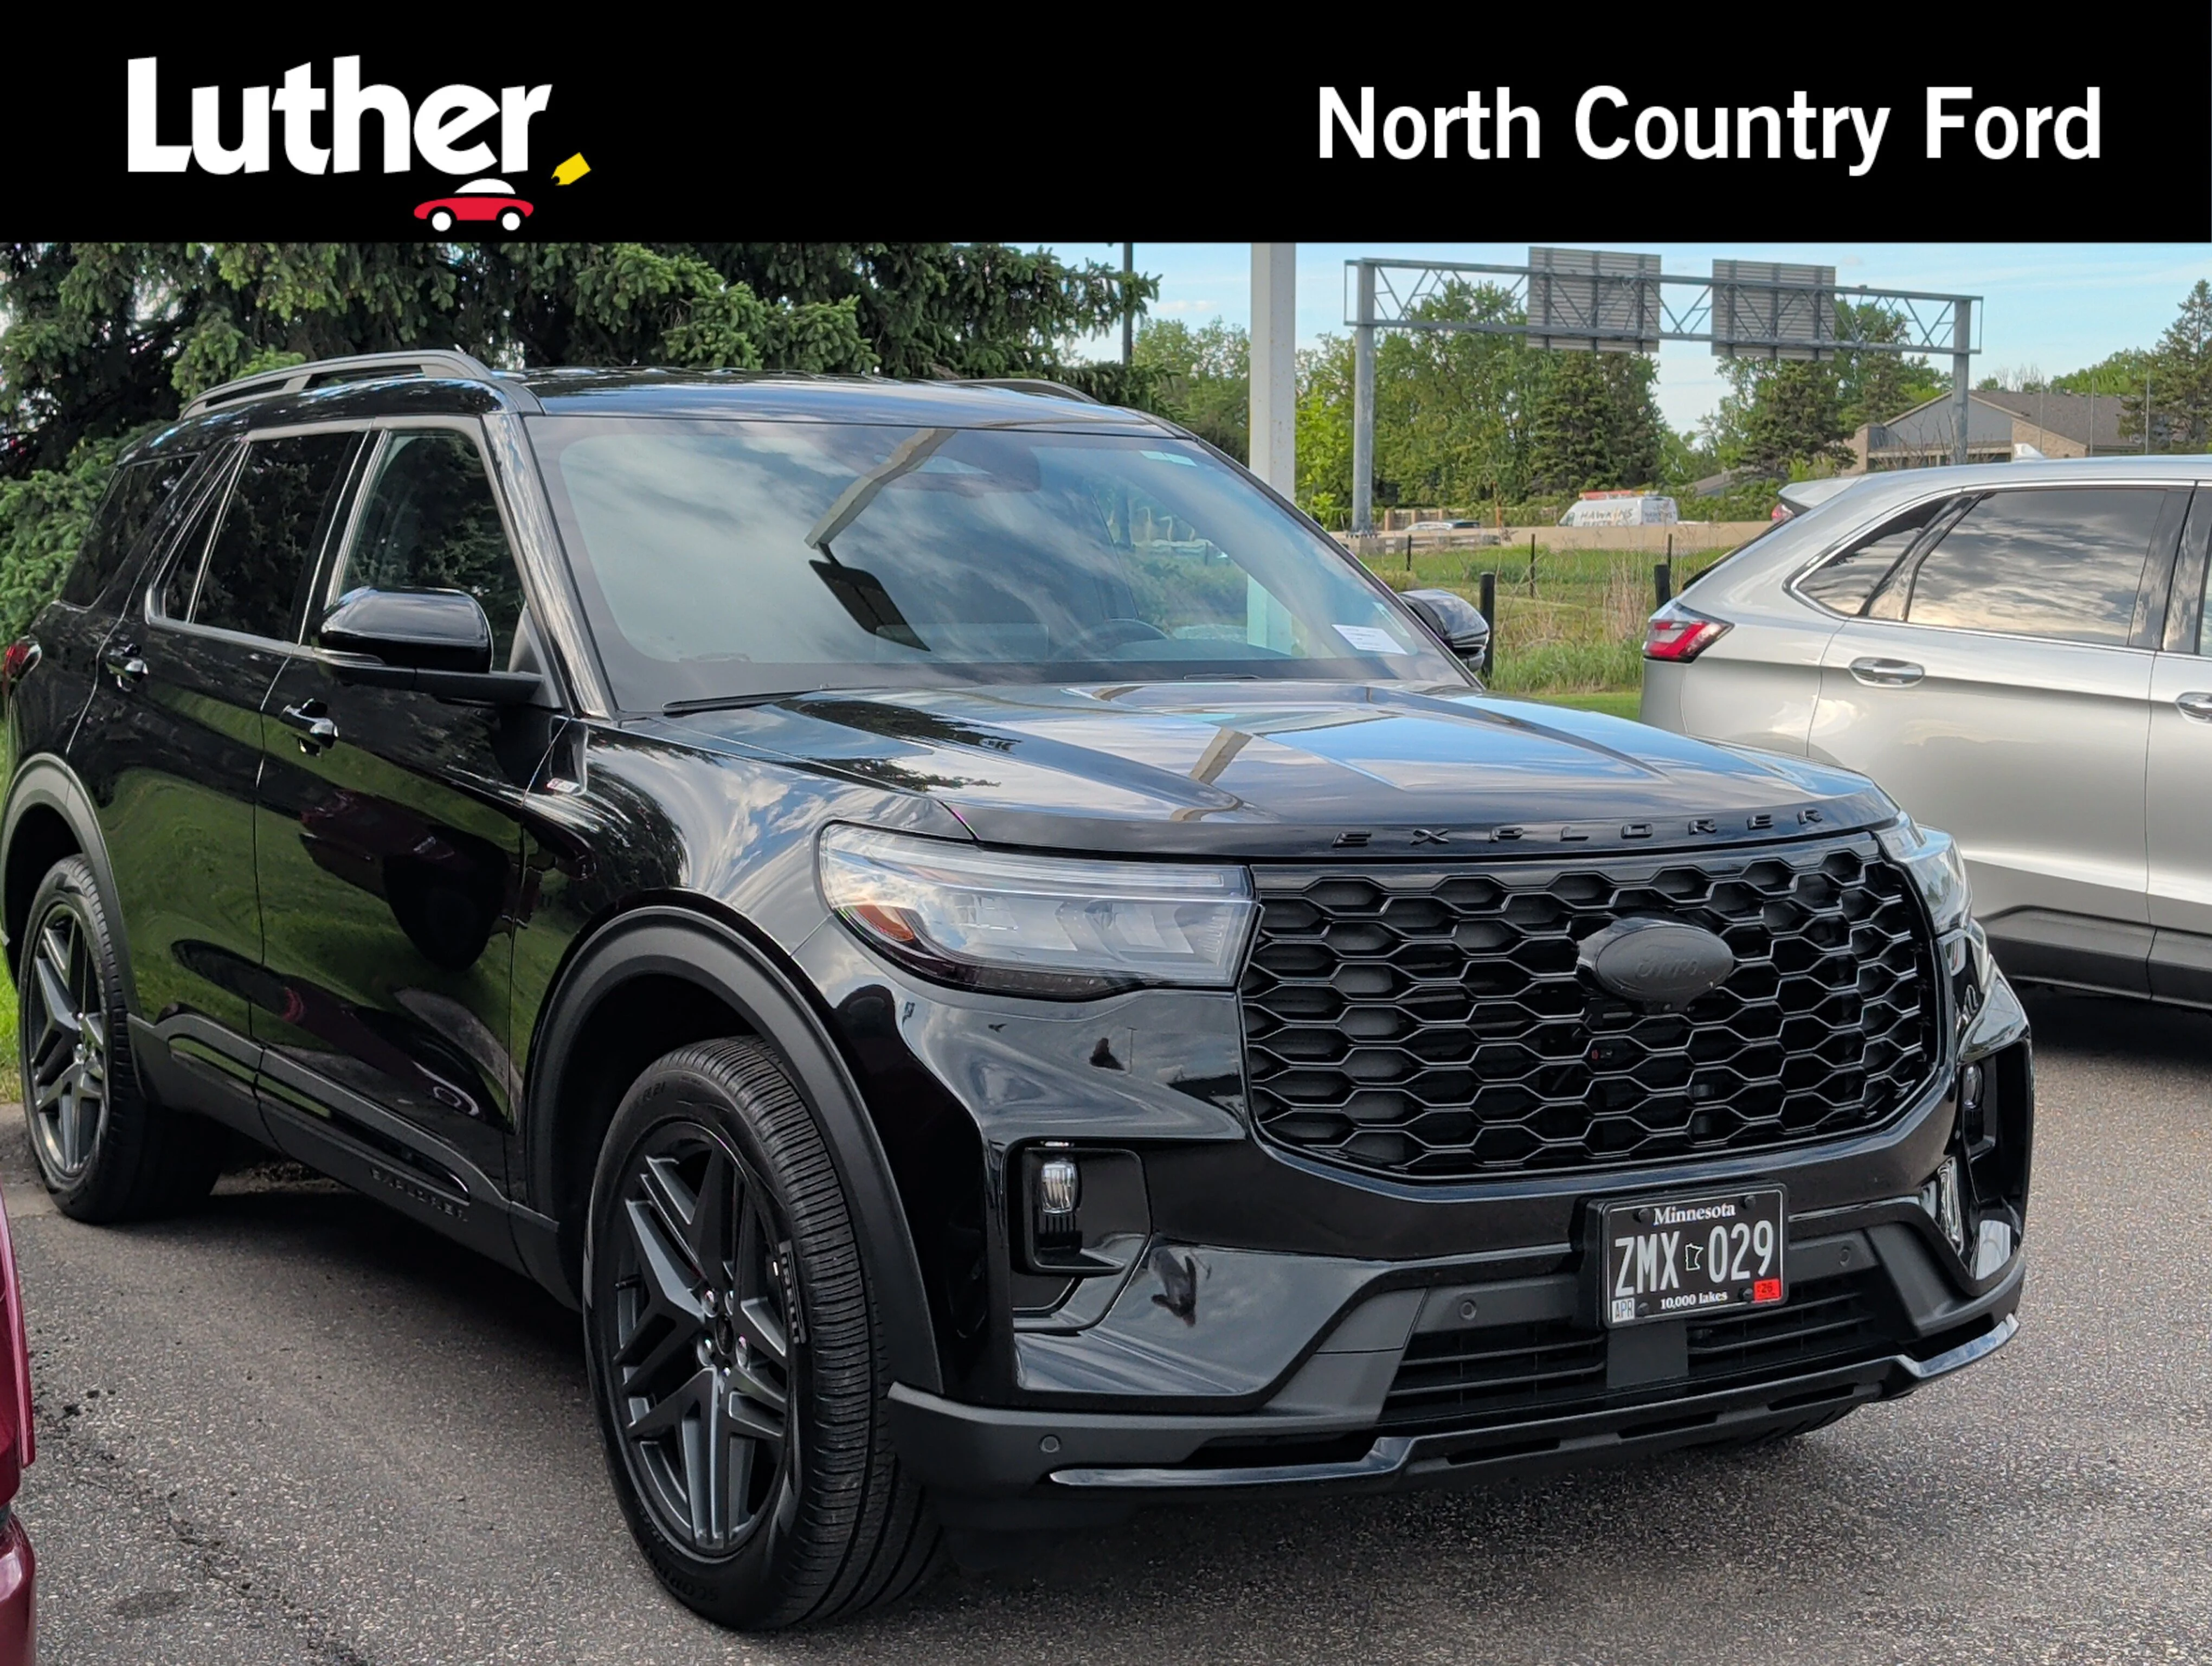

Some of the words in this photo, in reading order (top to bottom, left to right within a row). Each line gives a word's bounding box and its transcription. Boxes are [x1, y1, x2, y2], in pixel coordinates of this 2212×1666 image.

[1332, 808, 1823, 848] EXPLORER
[1653, 1202, 1737, 1226] Minnesota
[1615, 1231, 1681, 1298] ZMX
[1708, 1220, 1774, 1283] 029
[1615, 1299, 1633, 1319] APR
[1660, 1295, 1697, 1310] 10,000
[1699, 1290, 1728, 1304] lakes
